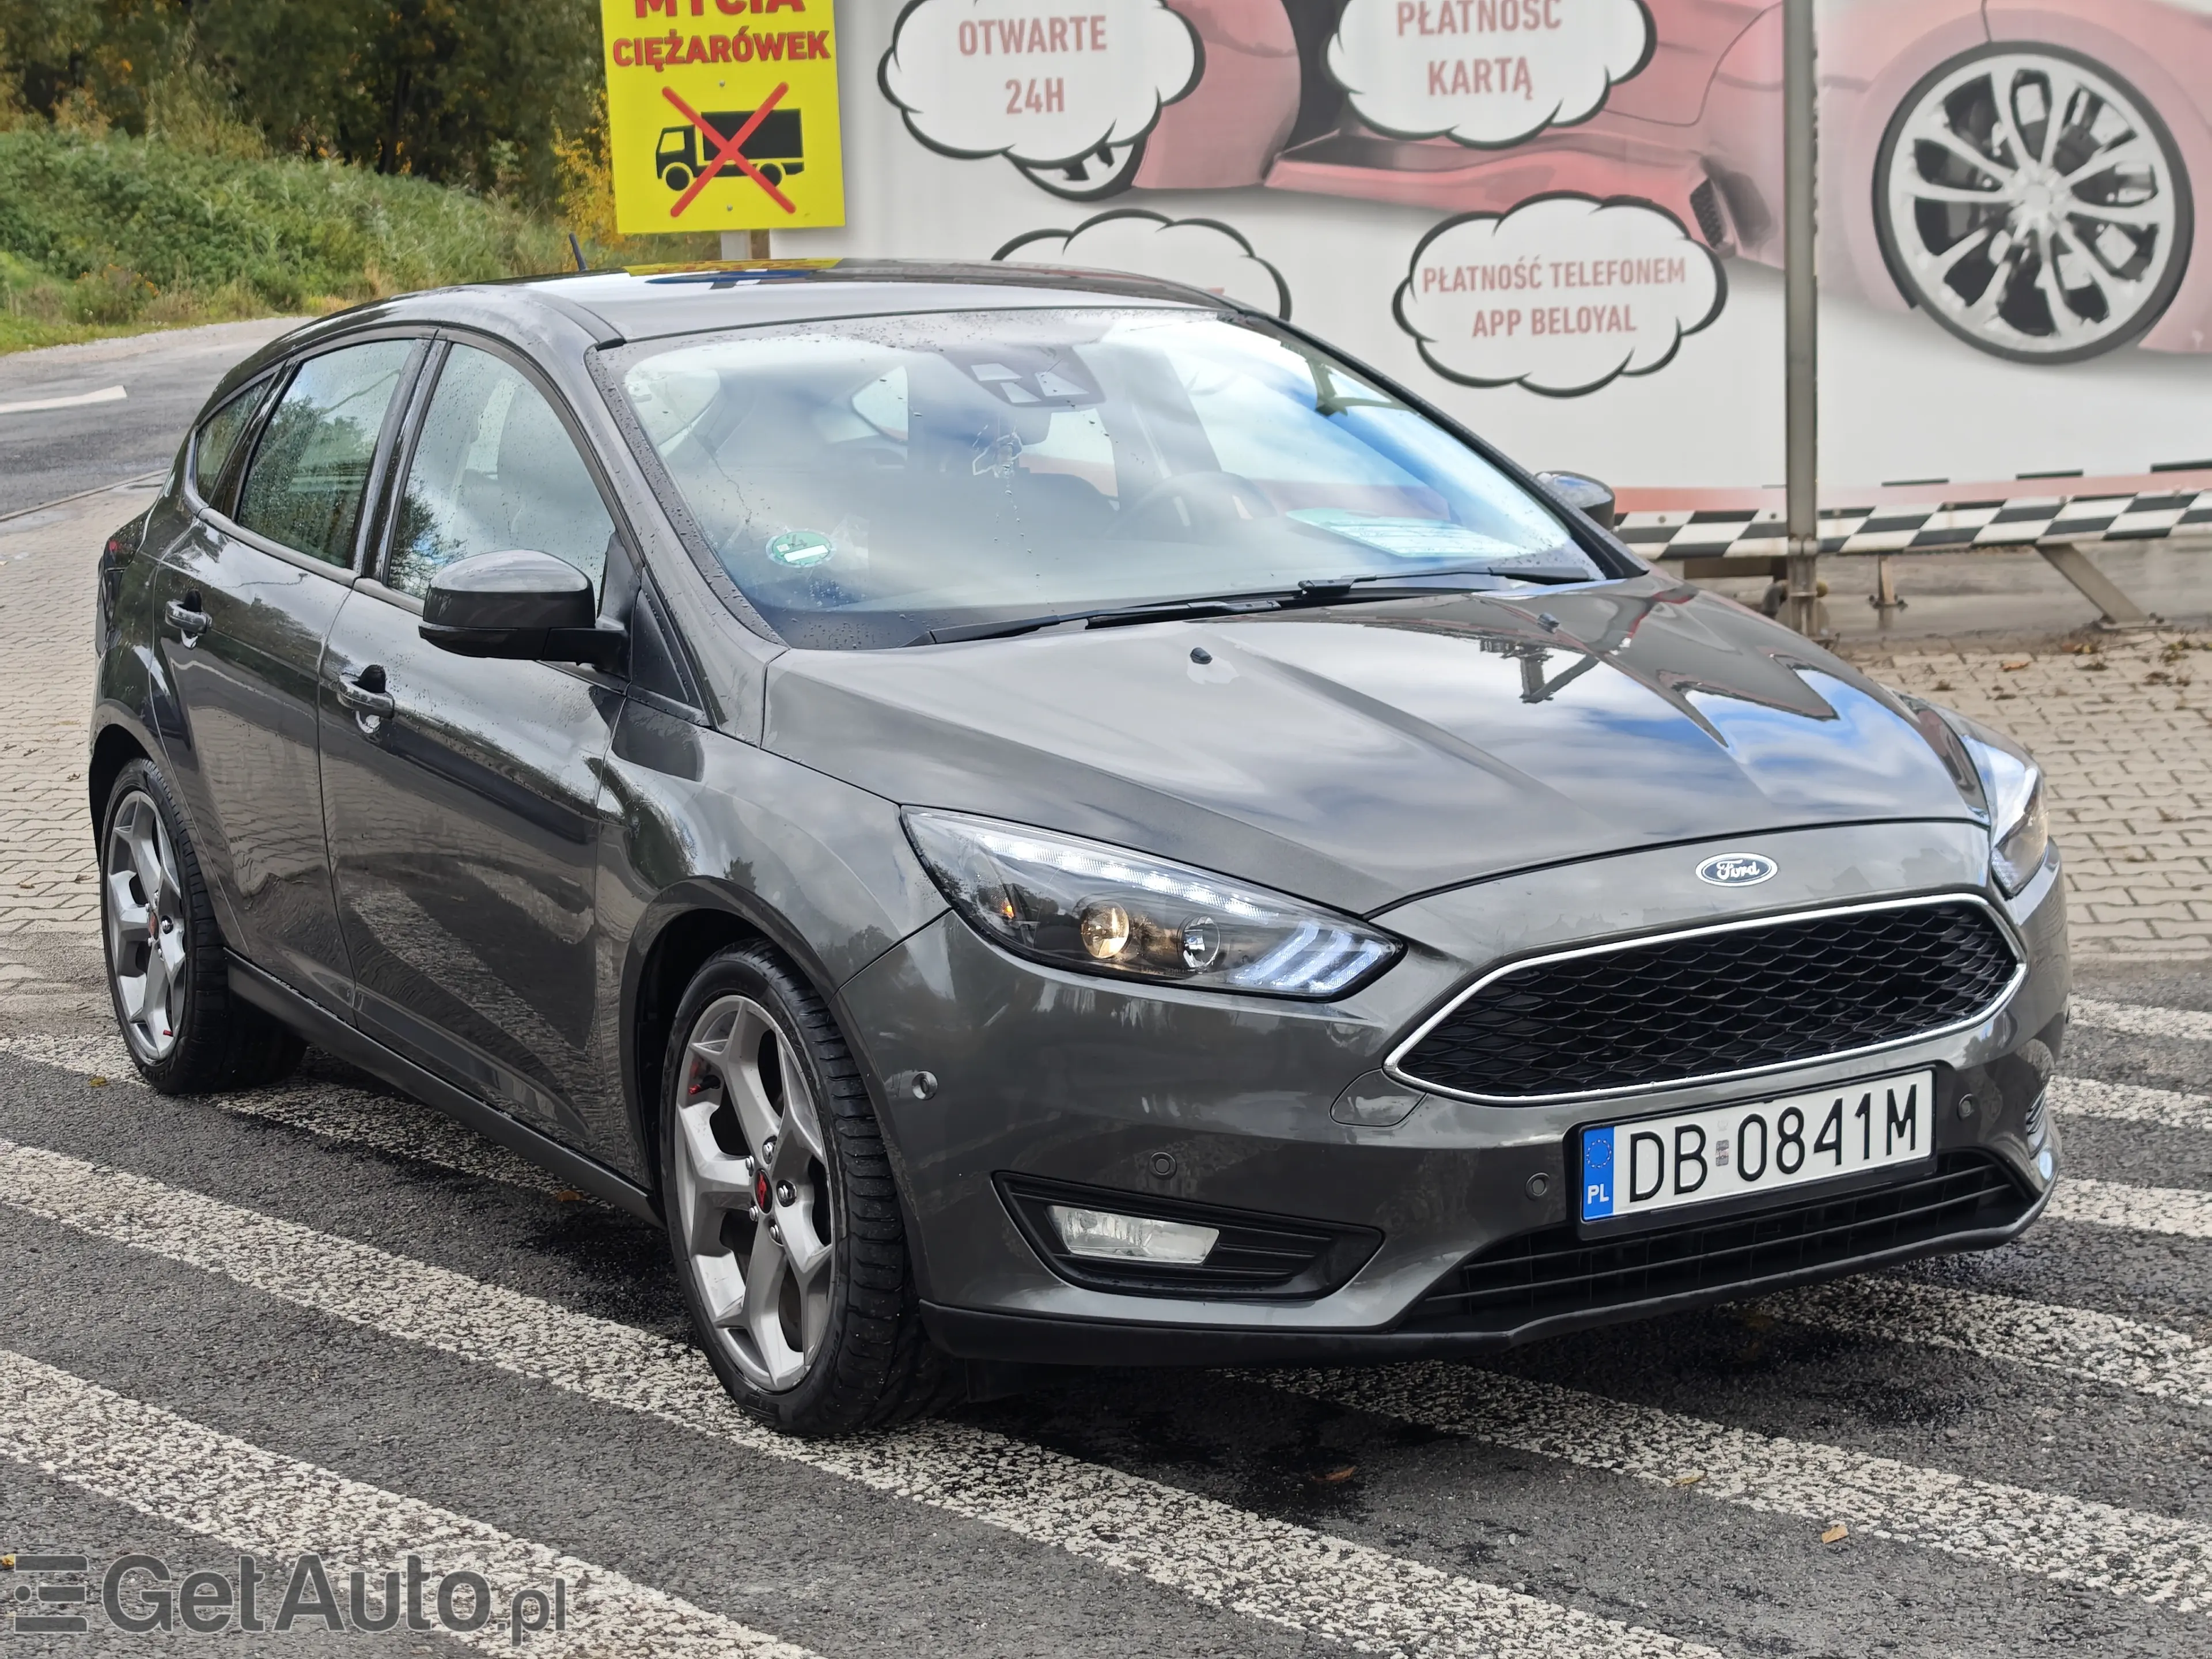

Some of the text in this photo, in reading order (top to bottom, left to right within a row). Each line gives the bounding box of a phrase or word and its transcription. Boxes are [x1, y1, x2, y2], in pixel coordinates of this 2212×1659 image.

[613, 26, 831, 72] CIĘŻARÓWEK
[959, 15, 1107, 56] OTWARTE
[1005, 77, 1065, 115] 24H
[1428, 56, 1533, 100] KARTĄ
[1422, 255, 1685, 293] PŁATNOŚĆ TELEFONEM
[1472, 304, 1637, 338] APP BELOYAL
[1716, 859, 1760, 880] Ford
[1629, 1084, 1917, 1203] DB 0841M
[1588, 1183, 1609, 1205] PL
